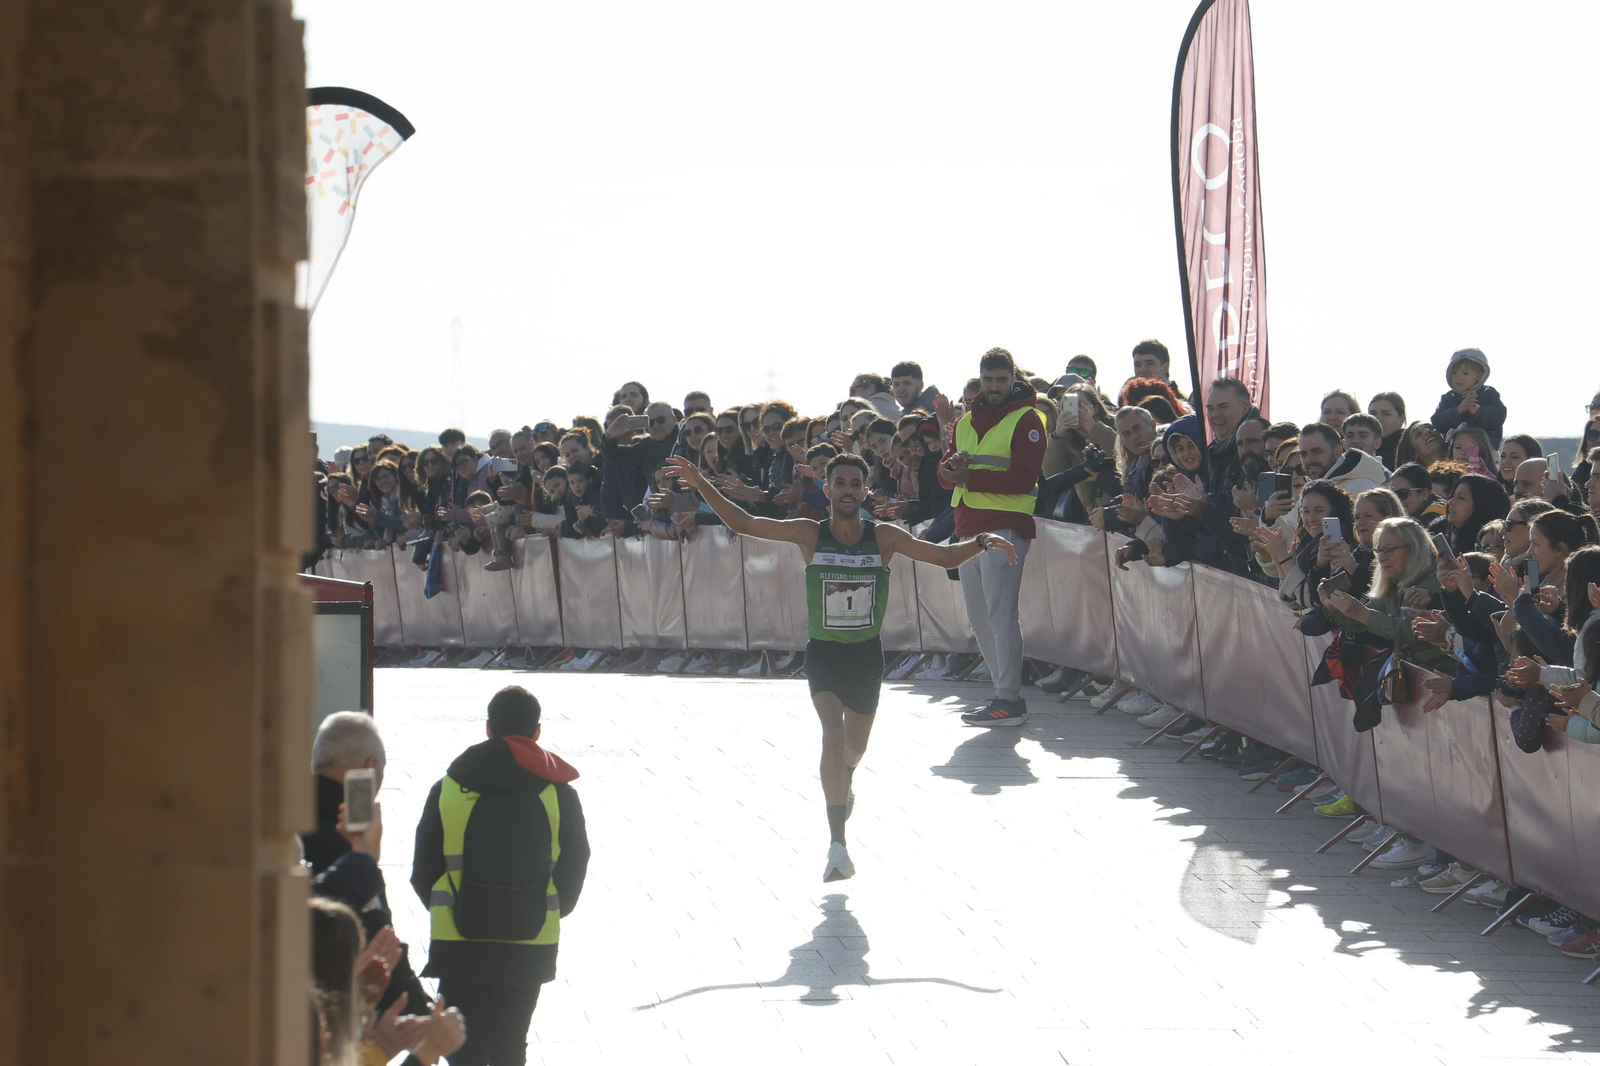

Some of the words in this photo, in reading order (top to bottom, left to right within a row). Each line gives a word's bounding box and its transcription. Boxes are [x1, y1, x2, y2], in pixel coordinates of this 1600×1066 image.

[1230, 116, 1248, 209] Córdoba
[1245, 319, 1257, 346] de
[846, 596, 852, 610] 1
